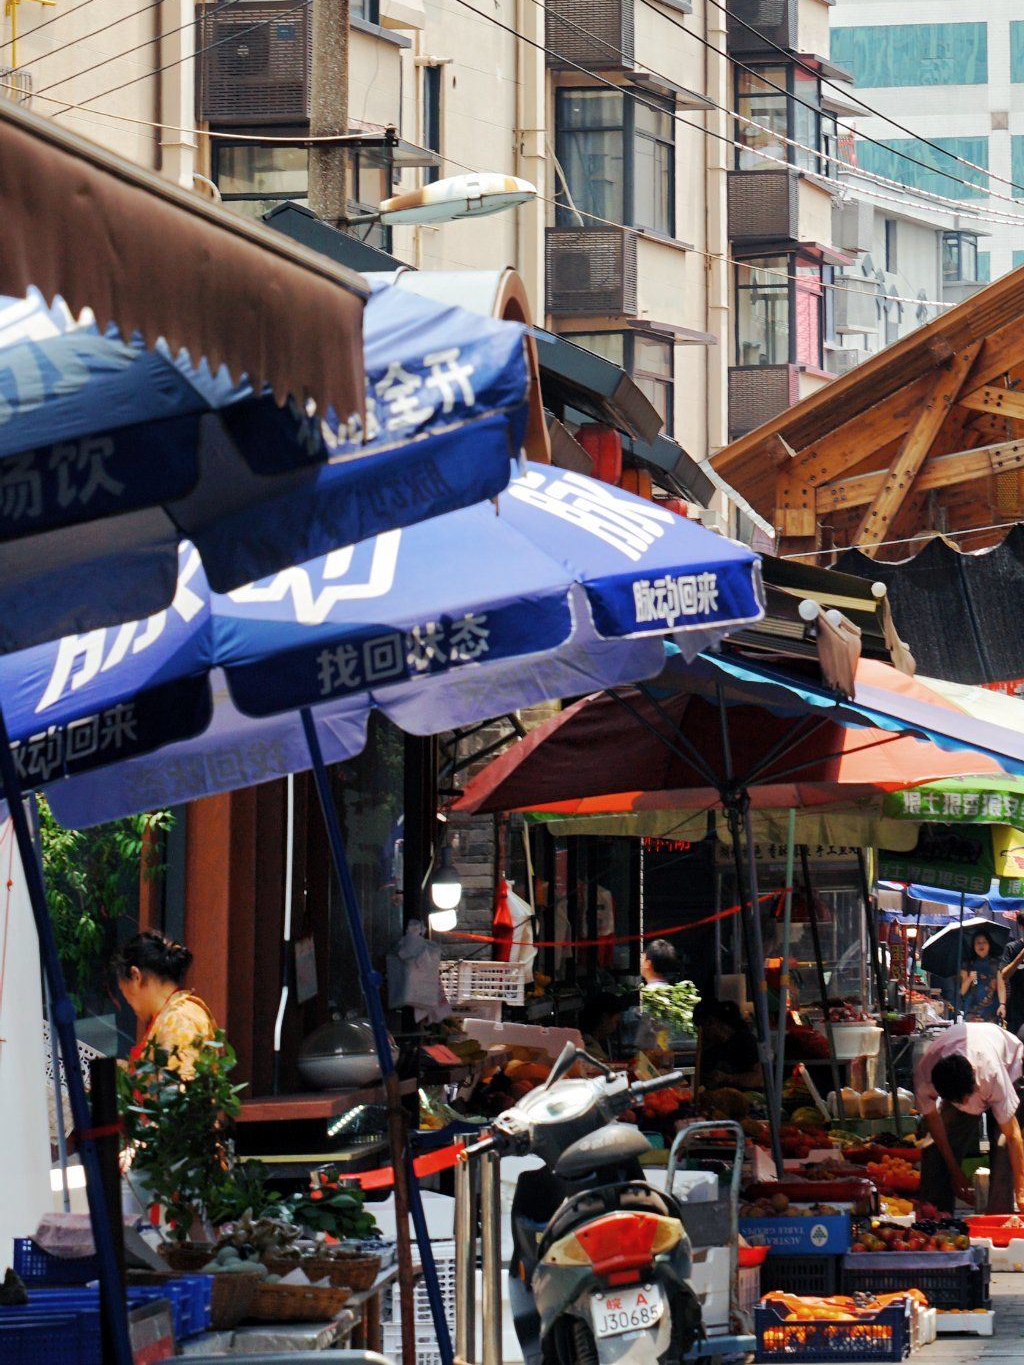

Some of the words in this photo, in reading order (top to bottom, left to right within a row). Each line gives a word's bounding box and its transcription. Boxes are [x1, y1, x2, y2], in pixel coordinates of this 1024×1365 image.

[633, 572, 719, 628] 脉动回来
[317, 613, 491, 695] 找回状态
[600, 1305, 659, 1333] J30685
[606, 1297, 622, 1310] 皖
[636, 1292, 648, 1306] A
